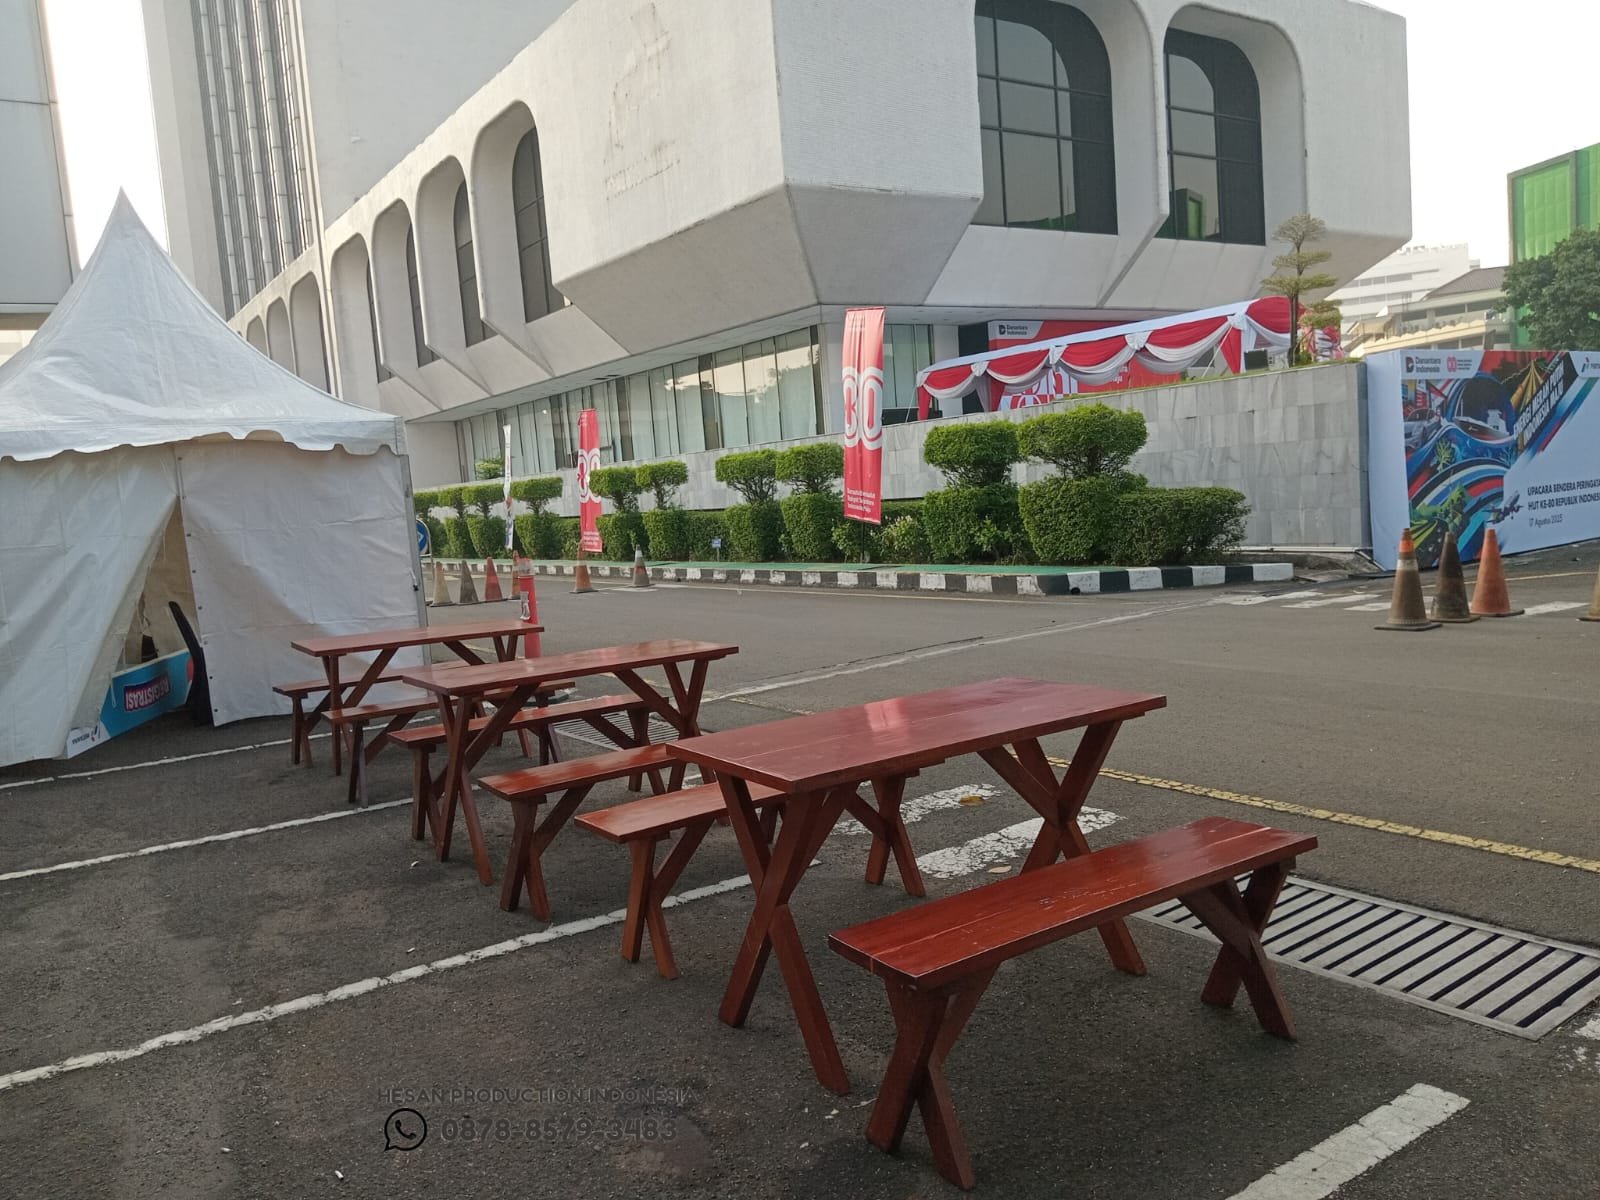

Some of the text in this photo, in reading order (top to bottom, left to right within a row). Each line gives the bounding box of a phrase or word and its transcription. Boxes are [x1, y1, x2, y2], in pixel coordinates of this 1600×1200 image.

[1528, 484, 1552, 496] UPACARA
[1553, 482, 1576, 493] BENDERA
[1528, 500, 1539, 511] HUT
[1556, 495, 1578, 507] REPUBLIK
[126, 677, 170, 710] REGISTRASI
